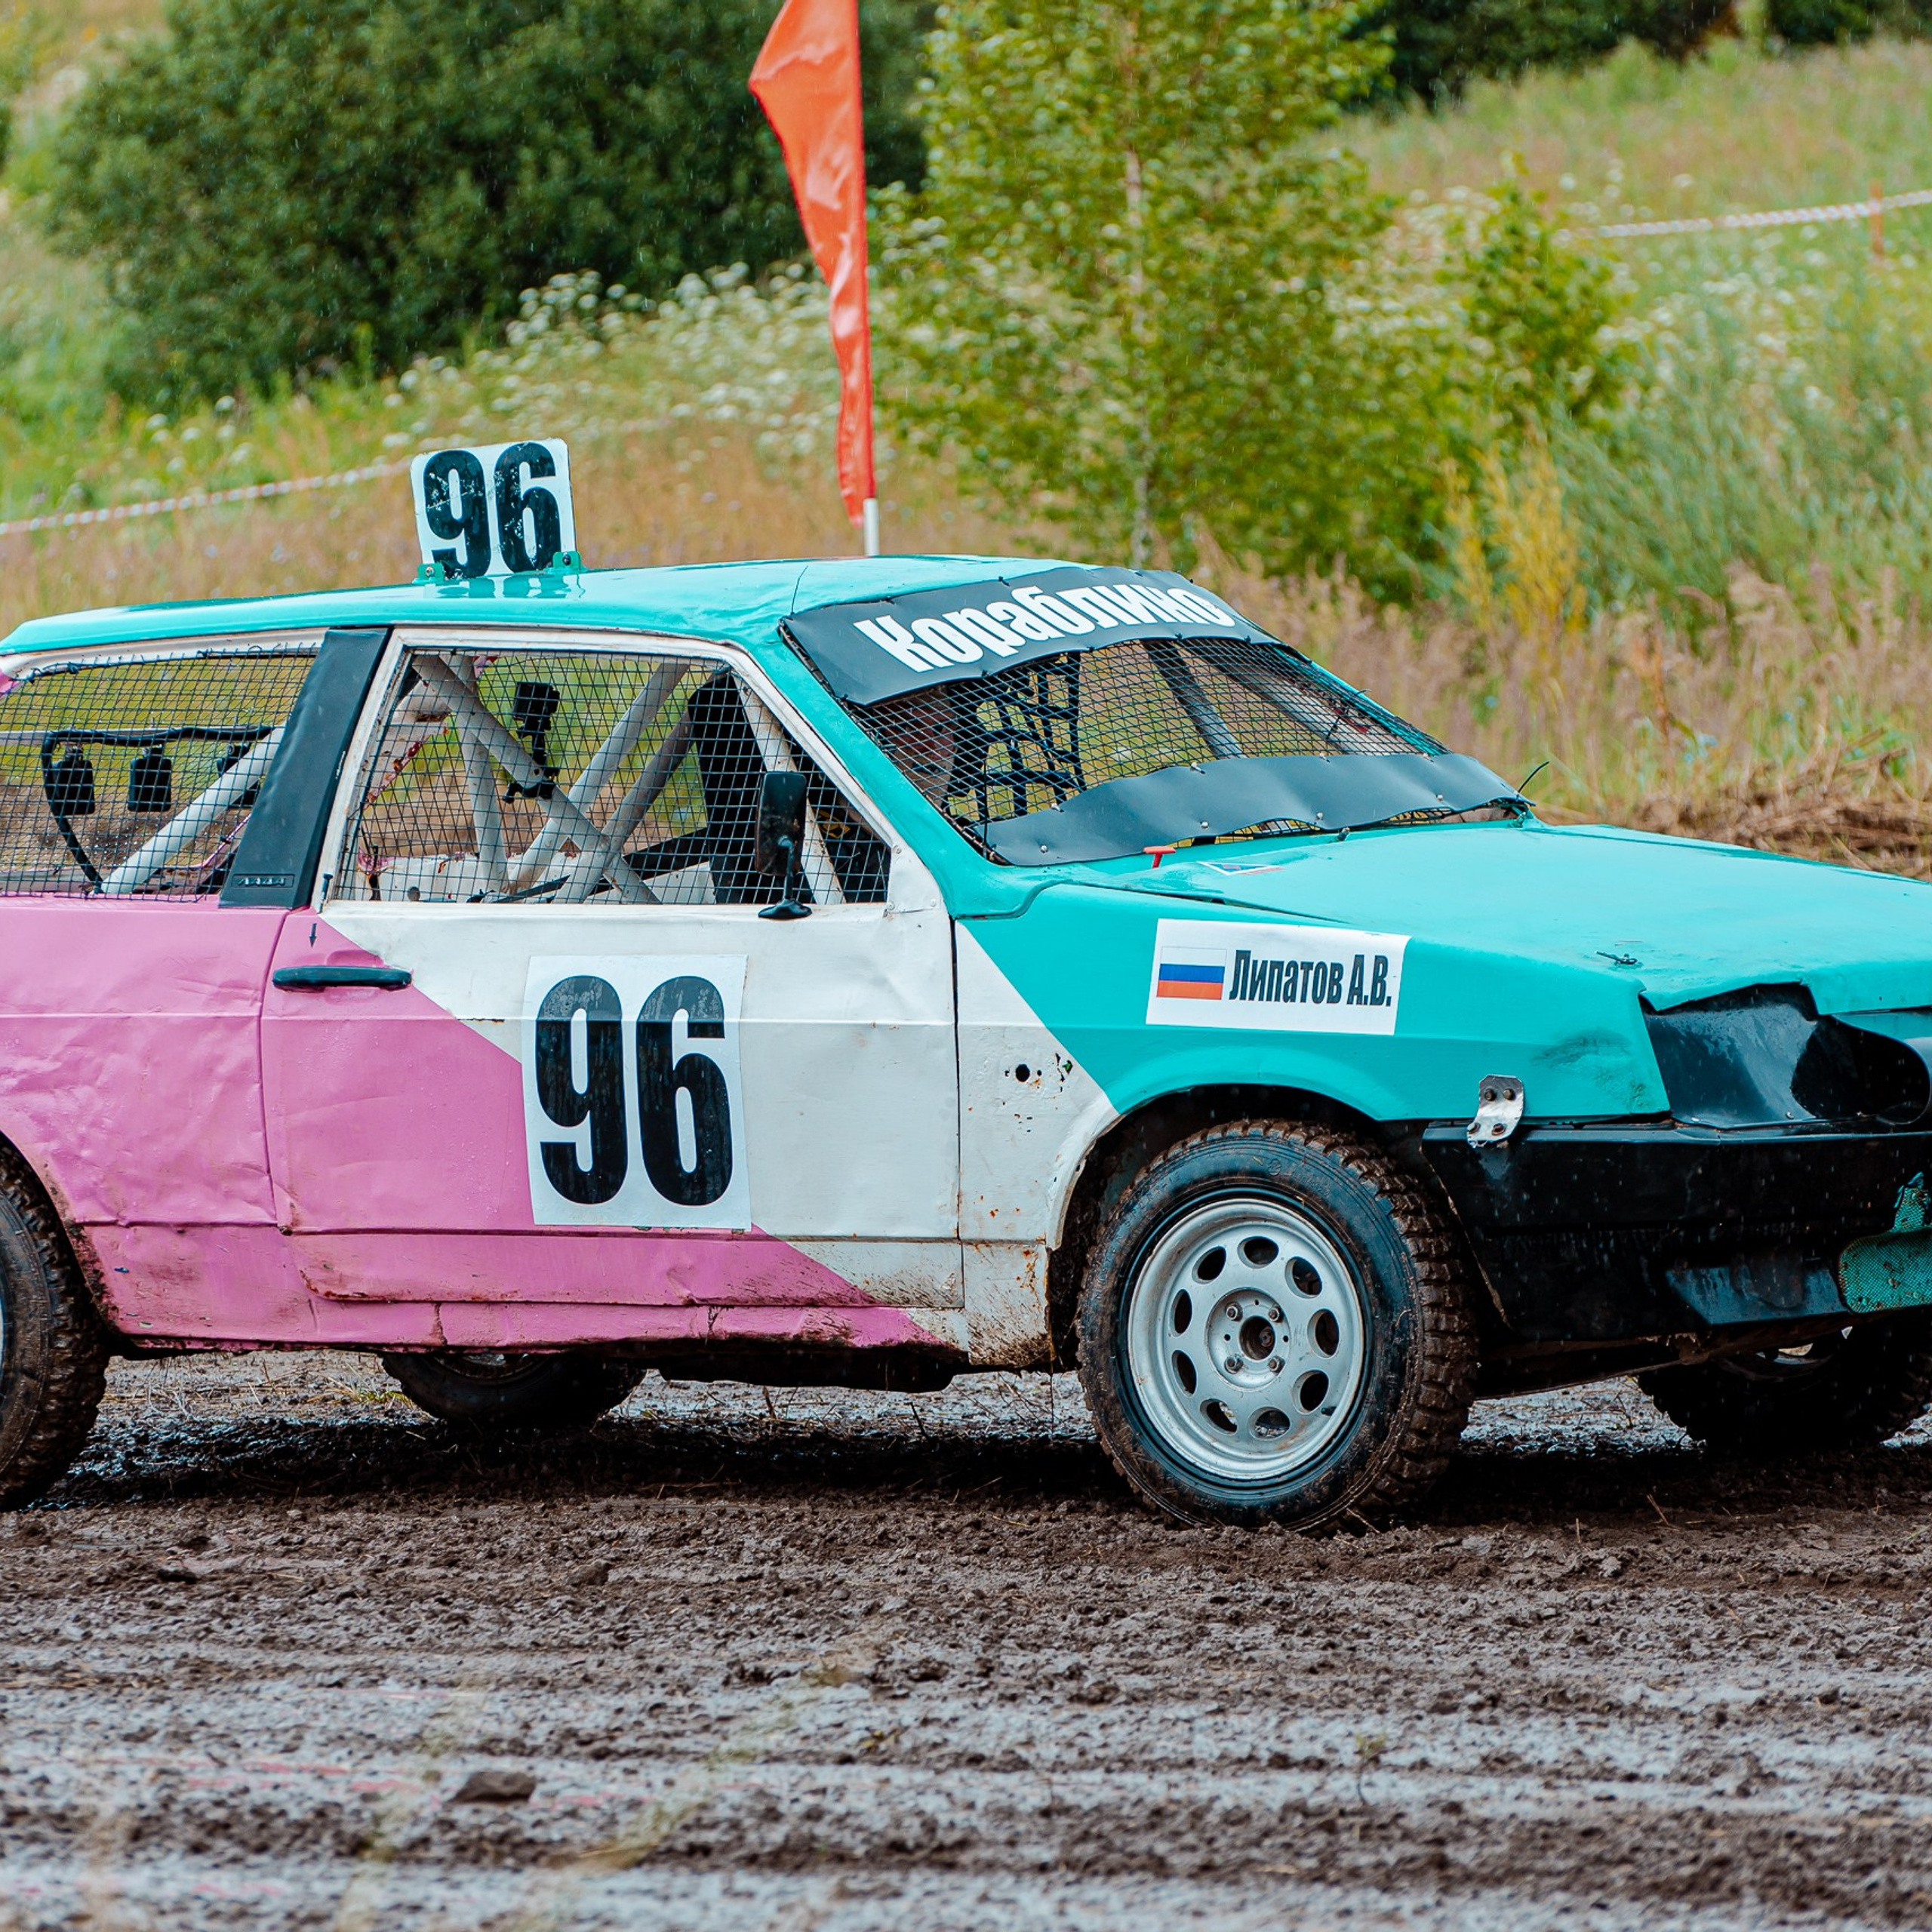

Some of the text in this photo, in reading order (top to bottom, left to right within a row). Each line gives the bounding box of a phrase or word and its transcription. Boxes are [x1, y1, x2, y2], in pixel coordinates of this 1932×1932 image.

[423, 441, 561, 580] 96
[854, 584, 1235, 673] Кораблино
[1229, 949, 1392, 1007] Липатов А.В.
[535, 974, 733, 1206] 96
